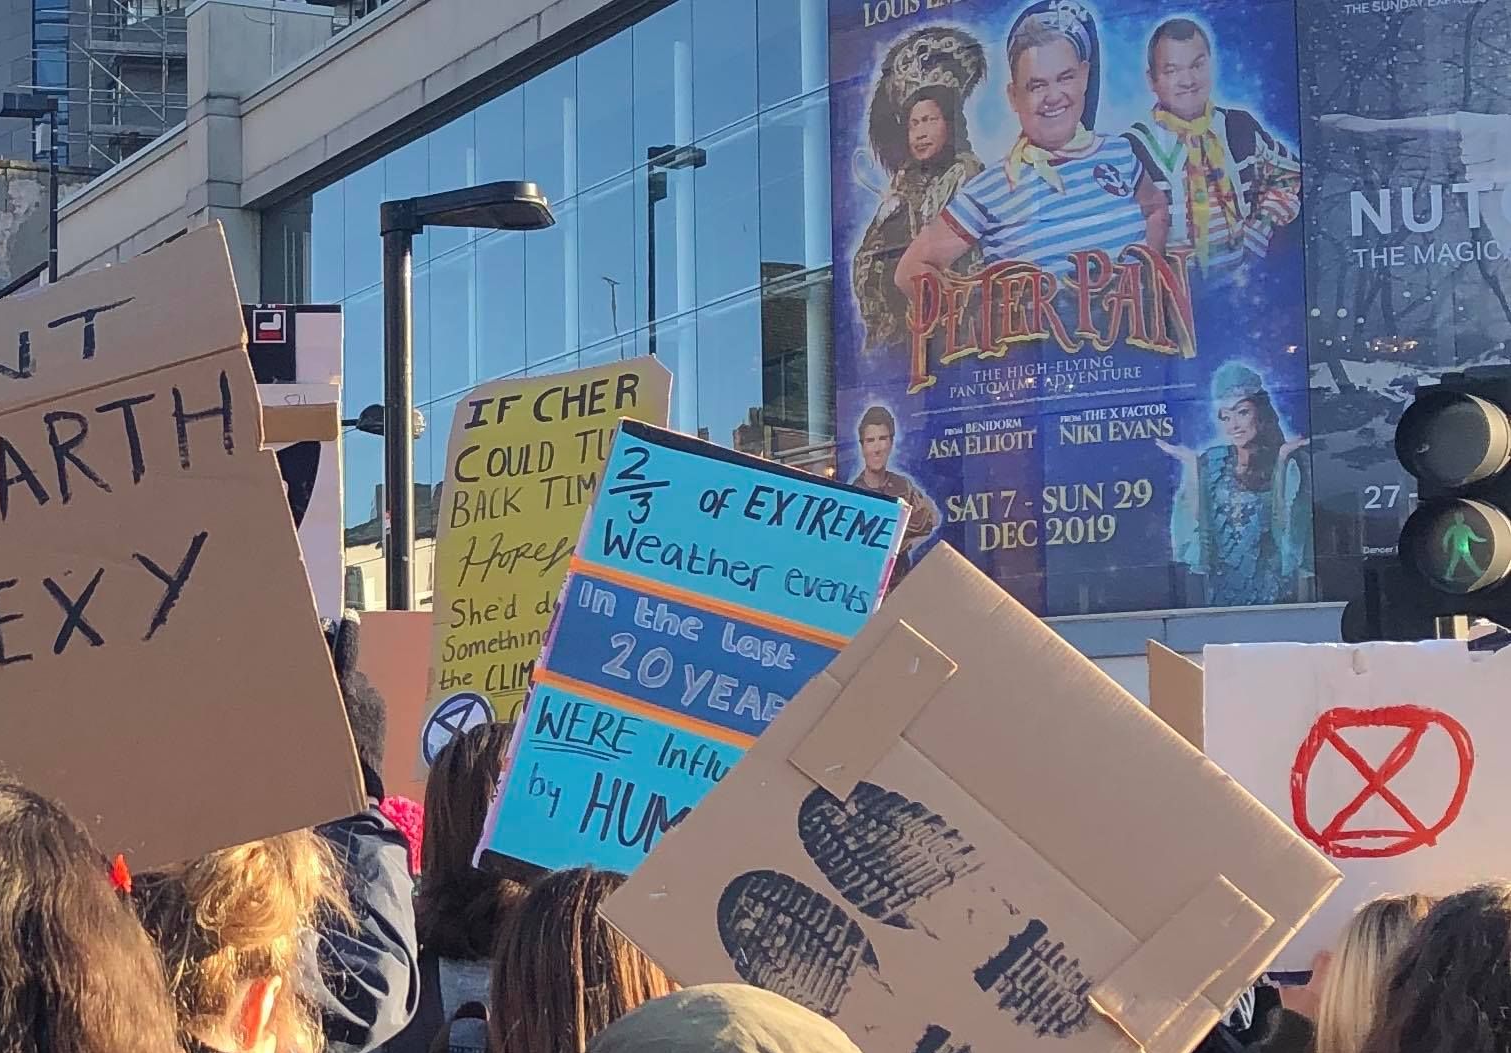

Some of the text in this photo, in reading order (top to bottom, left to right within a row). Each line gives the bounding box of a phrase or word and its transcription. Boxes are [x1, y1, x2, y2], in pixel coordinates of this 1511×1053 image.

[863, 0, 921, 27] LOUIS
[1344, 4, 1370, 16] THE
[1350, 182, 1511, 237] NUT
[1352, 240, 1503, 269] THE MAGIC
[906, 244, 1197, 395] PETER PAN
[949, 376, 1038, 400] PANTOMIME
[1044, 366, 1143, 387] ADVENTURE
[973, 355, 1115, 384] THE HIGH-FLYING
[463, 373, 640, 430] IF CHER
[1060, 403, 1168, 424] FROM THE X FACTOR
[927, 429, 1037, 460] ASA ELLIOTT
[944, 418, 1022, 436] FROM BENIDORM
[1060, 417, 1174, 446] NIKI EVANS
[454, 440, 555, 483] COULD
[450, 486, 524, 529] BACK
[743, 484, 898, 549] EXTREME
[947, 491, 994, 523] SAT
[1001, 490, 1017, 518] 7
[1042, 482, 1104, 514] SUN
[1113, 478, 1153, 509] 29
[1364, 484, 1401, 509] 27
[979, 514, 1117, 552] DEC 2019
[457, 532, 576, 588] Hopef
[450, 592, 517, 629] She'd
[577, 580, 617, 618] In
[633, 596, 705, 642] the
[784, 567, 872, 615] events
[438, 668, 474, 691] the
[601, 632, 674, 689] 20
[535, 695, 642, 754] WERE
[527, 761, 562, 819] by
